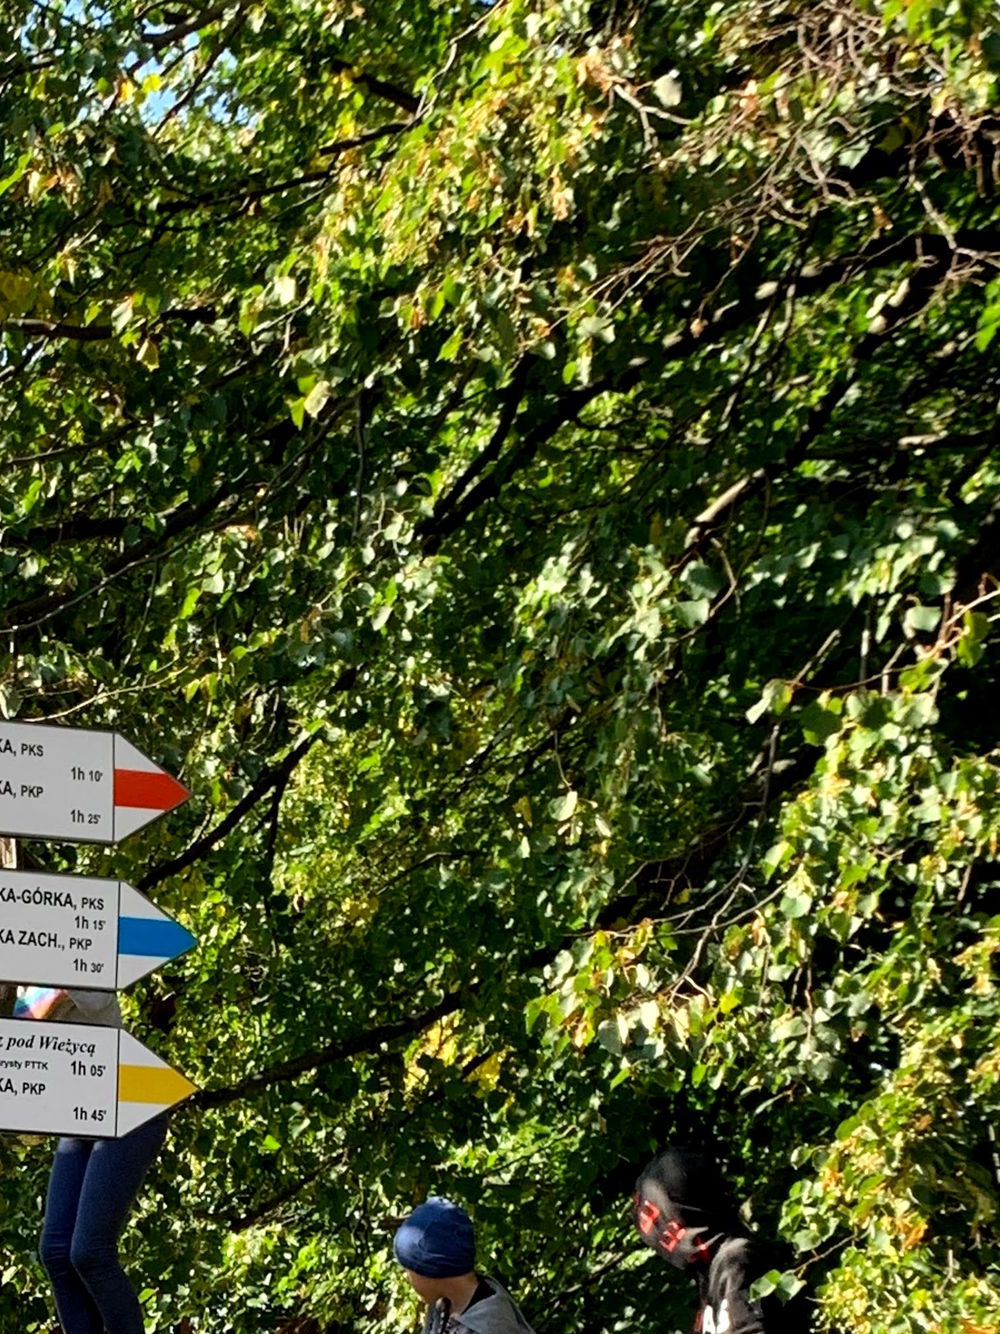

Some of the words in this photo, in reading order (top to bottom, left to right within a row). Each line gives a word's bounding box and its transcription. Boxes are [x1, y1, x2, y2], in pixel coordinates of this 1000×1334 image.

[20, 743, 44, 757] PKS
[70, 767, 85, 781] 1h
[20, 785, 44, 798] PKP
[70, 810, 85, 823] 1h
[81, 897, 104, 911] PKS
[74, 915, 89, 930] 1h
[18, 929, 65, 949] ZACH.,
[69, 937, 93, 951] PKP
[73, 958, 87, 973] 1h
[6, 1033, 34, 1050] pod
[38, 1035, 96, 1057] Wieżycą
[24, 1060, 48, 1071] PTTK
[70, 1061, 86, 1076] 1h
[22, 1082, 46, 1095] PKP
[73, 1107, 87, 1121] 1h
